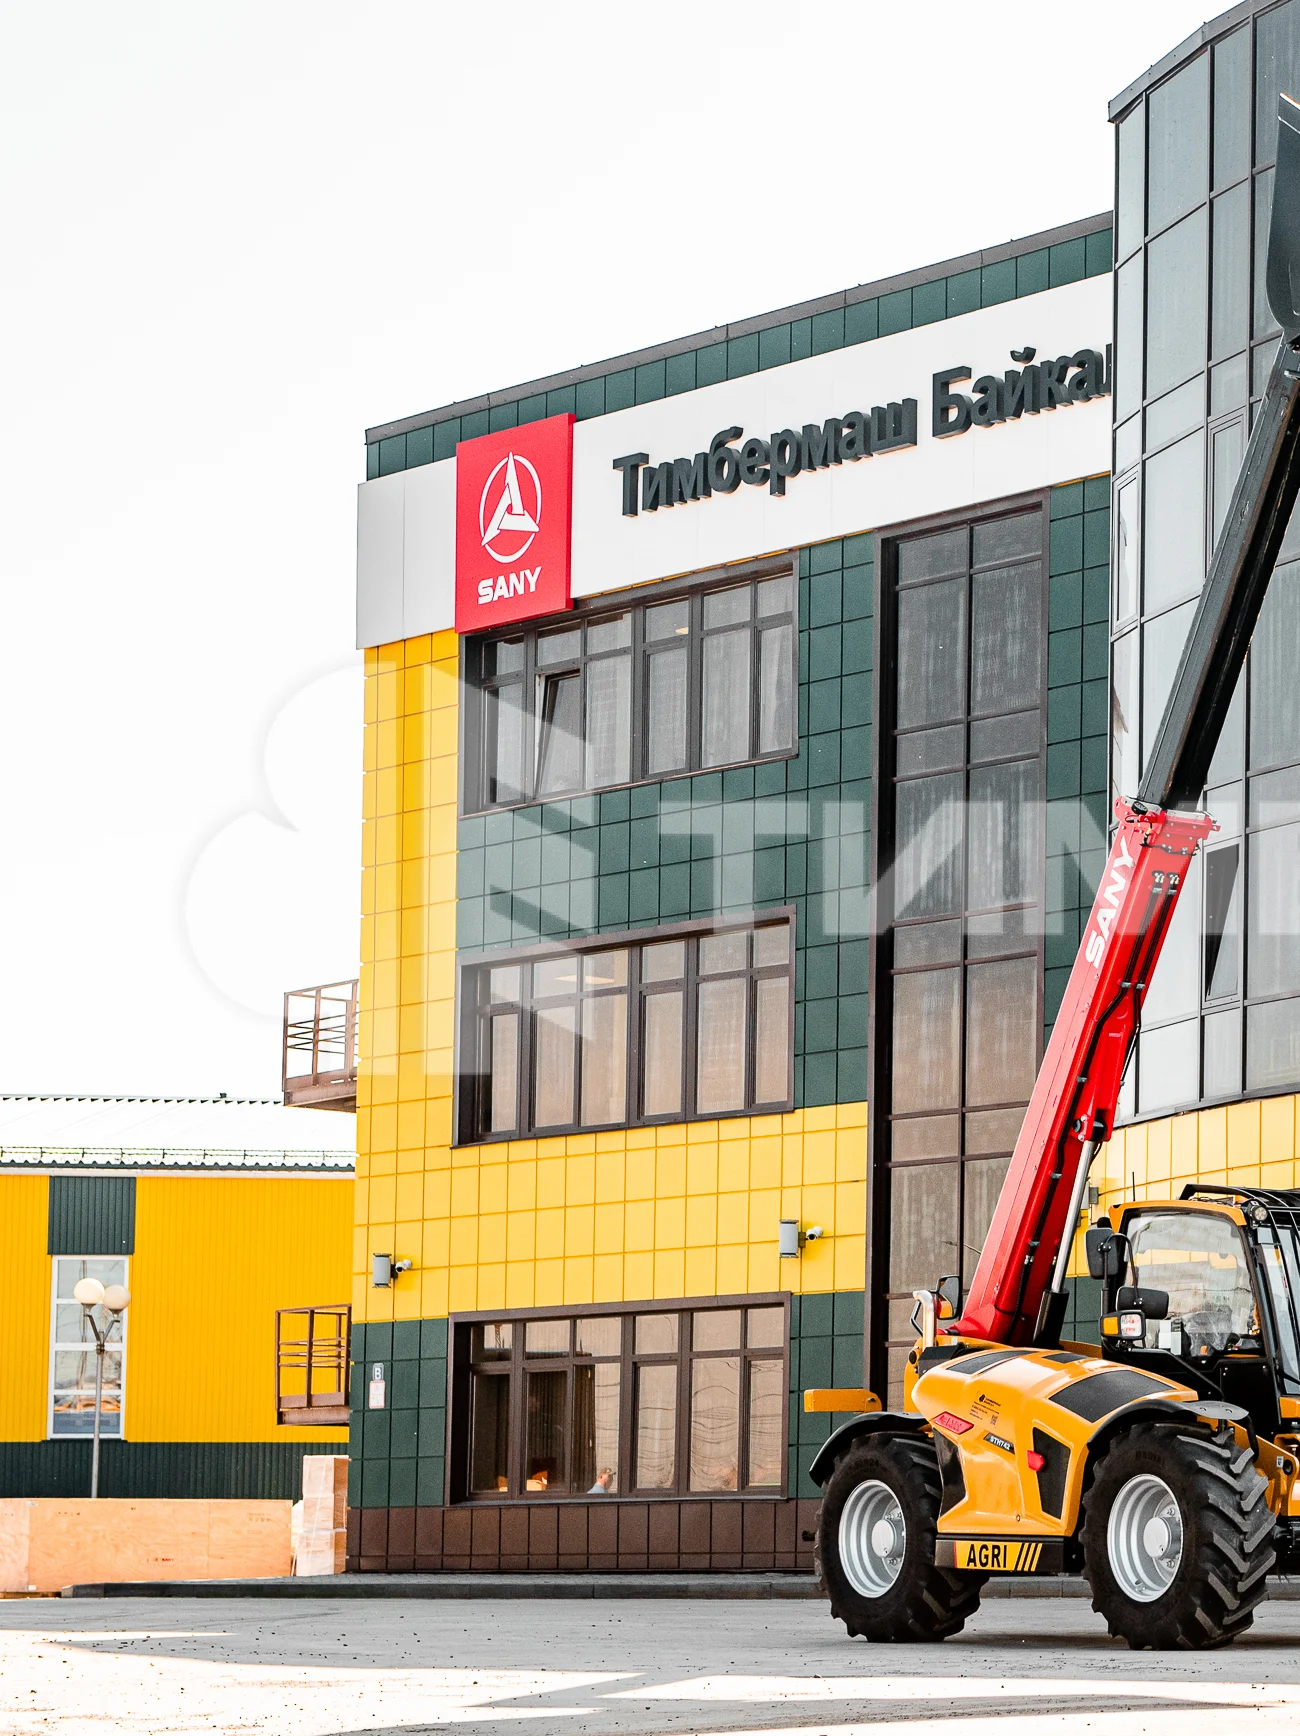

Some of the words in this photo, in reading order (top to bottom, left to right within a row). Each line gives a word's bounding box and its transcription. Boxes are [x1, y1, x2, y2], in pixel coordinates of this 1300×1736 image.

[613, 397, 918, 517] Тимбермаш
[477, 566, 542, 605] SANY
[1085, 834, 1134, 968] SANY
[990, 1435, 1011, 1451] STH742
[967, 1544, 1007, 1568] AGRI
